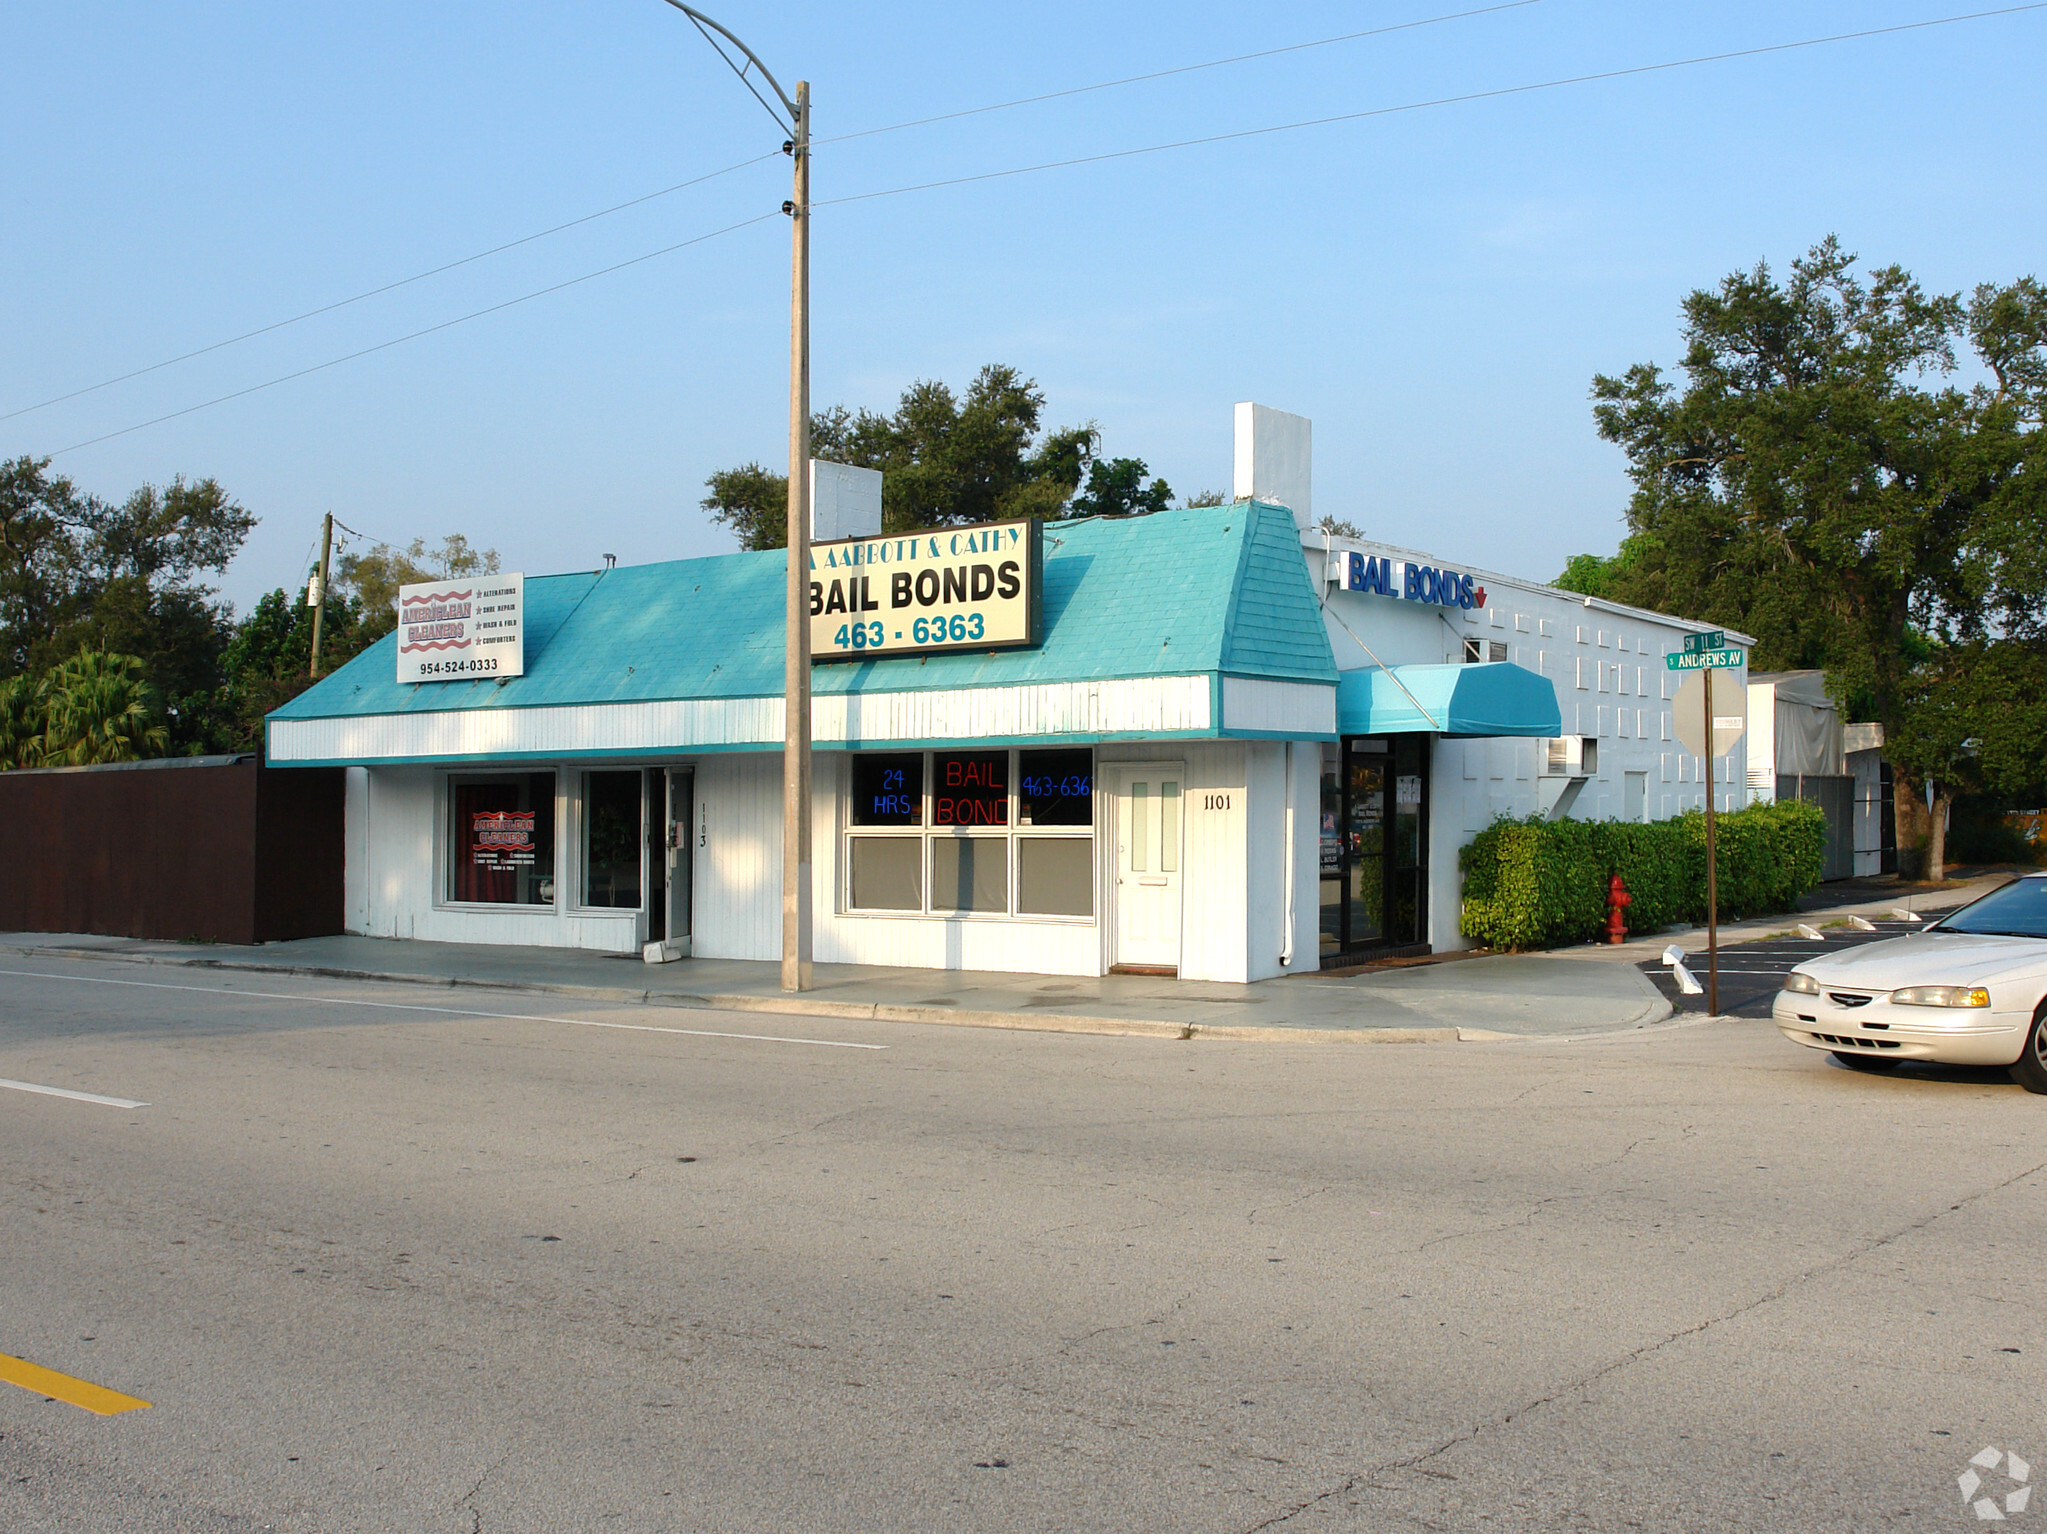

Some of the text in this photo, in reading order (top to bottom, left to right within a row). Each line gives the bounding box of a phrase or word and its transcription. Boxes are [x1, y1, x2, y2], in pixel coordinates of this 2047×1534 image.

[823, 538, 920, 569] AABBOTT
[927, 535, 942, 558] &
[950, 527, 1023, 557] CATHY
[810, 560, 1021, 616] BAIL BONDS
[1349, 552, 1473, 610] BAIL BONDS
[408, 622, 464, 642] CLEANERS
[1685, 636, 1695, 651] SW
[1715, 632, 1723, 646] ST
[420, 658, 498, 675] 954-524-0333
[1669, 651, 1741, 668] S ANDREWS AV
[883, 769, 905, 790] 24
[946, 761, 1004, 787] BAIL
[1023, 776, 1093, 796] 463-636
[874, 795, 911, 814] HRS
[1204, 795, 1231, 810] 1101
[479, 832, 529, 844] CLEANERS
